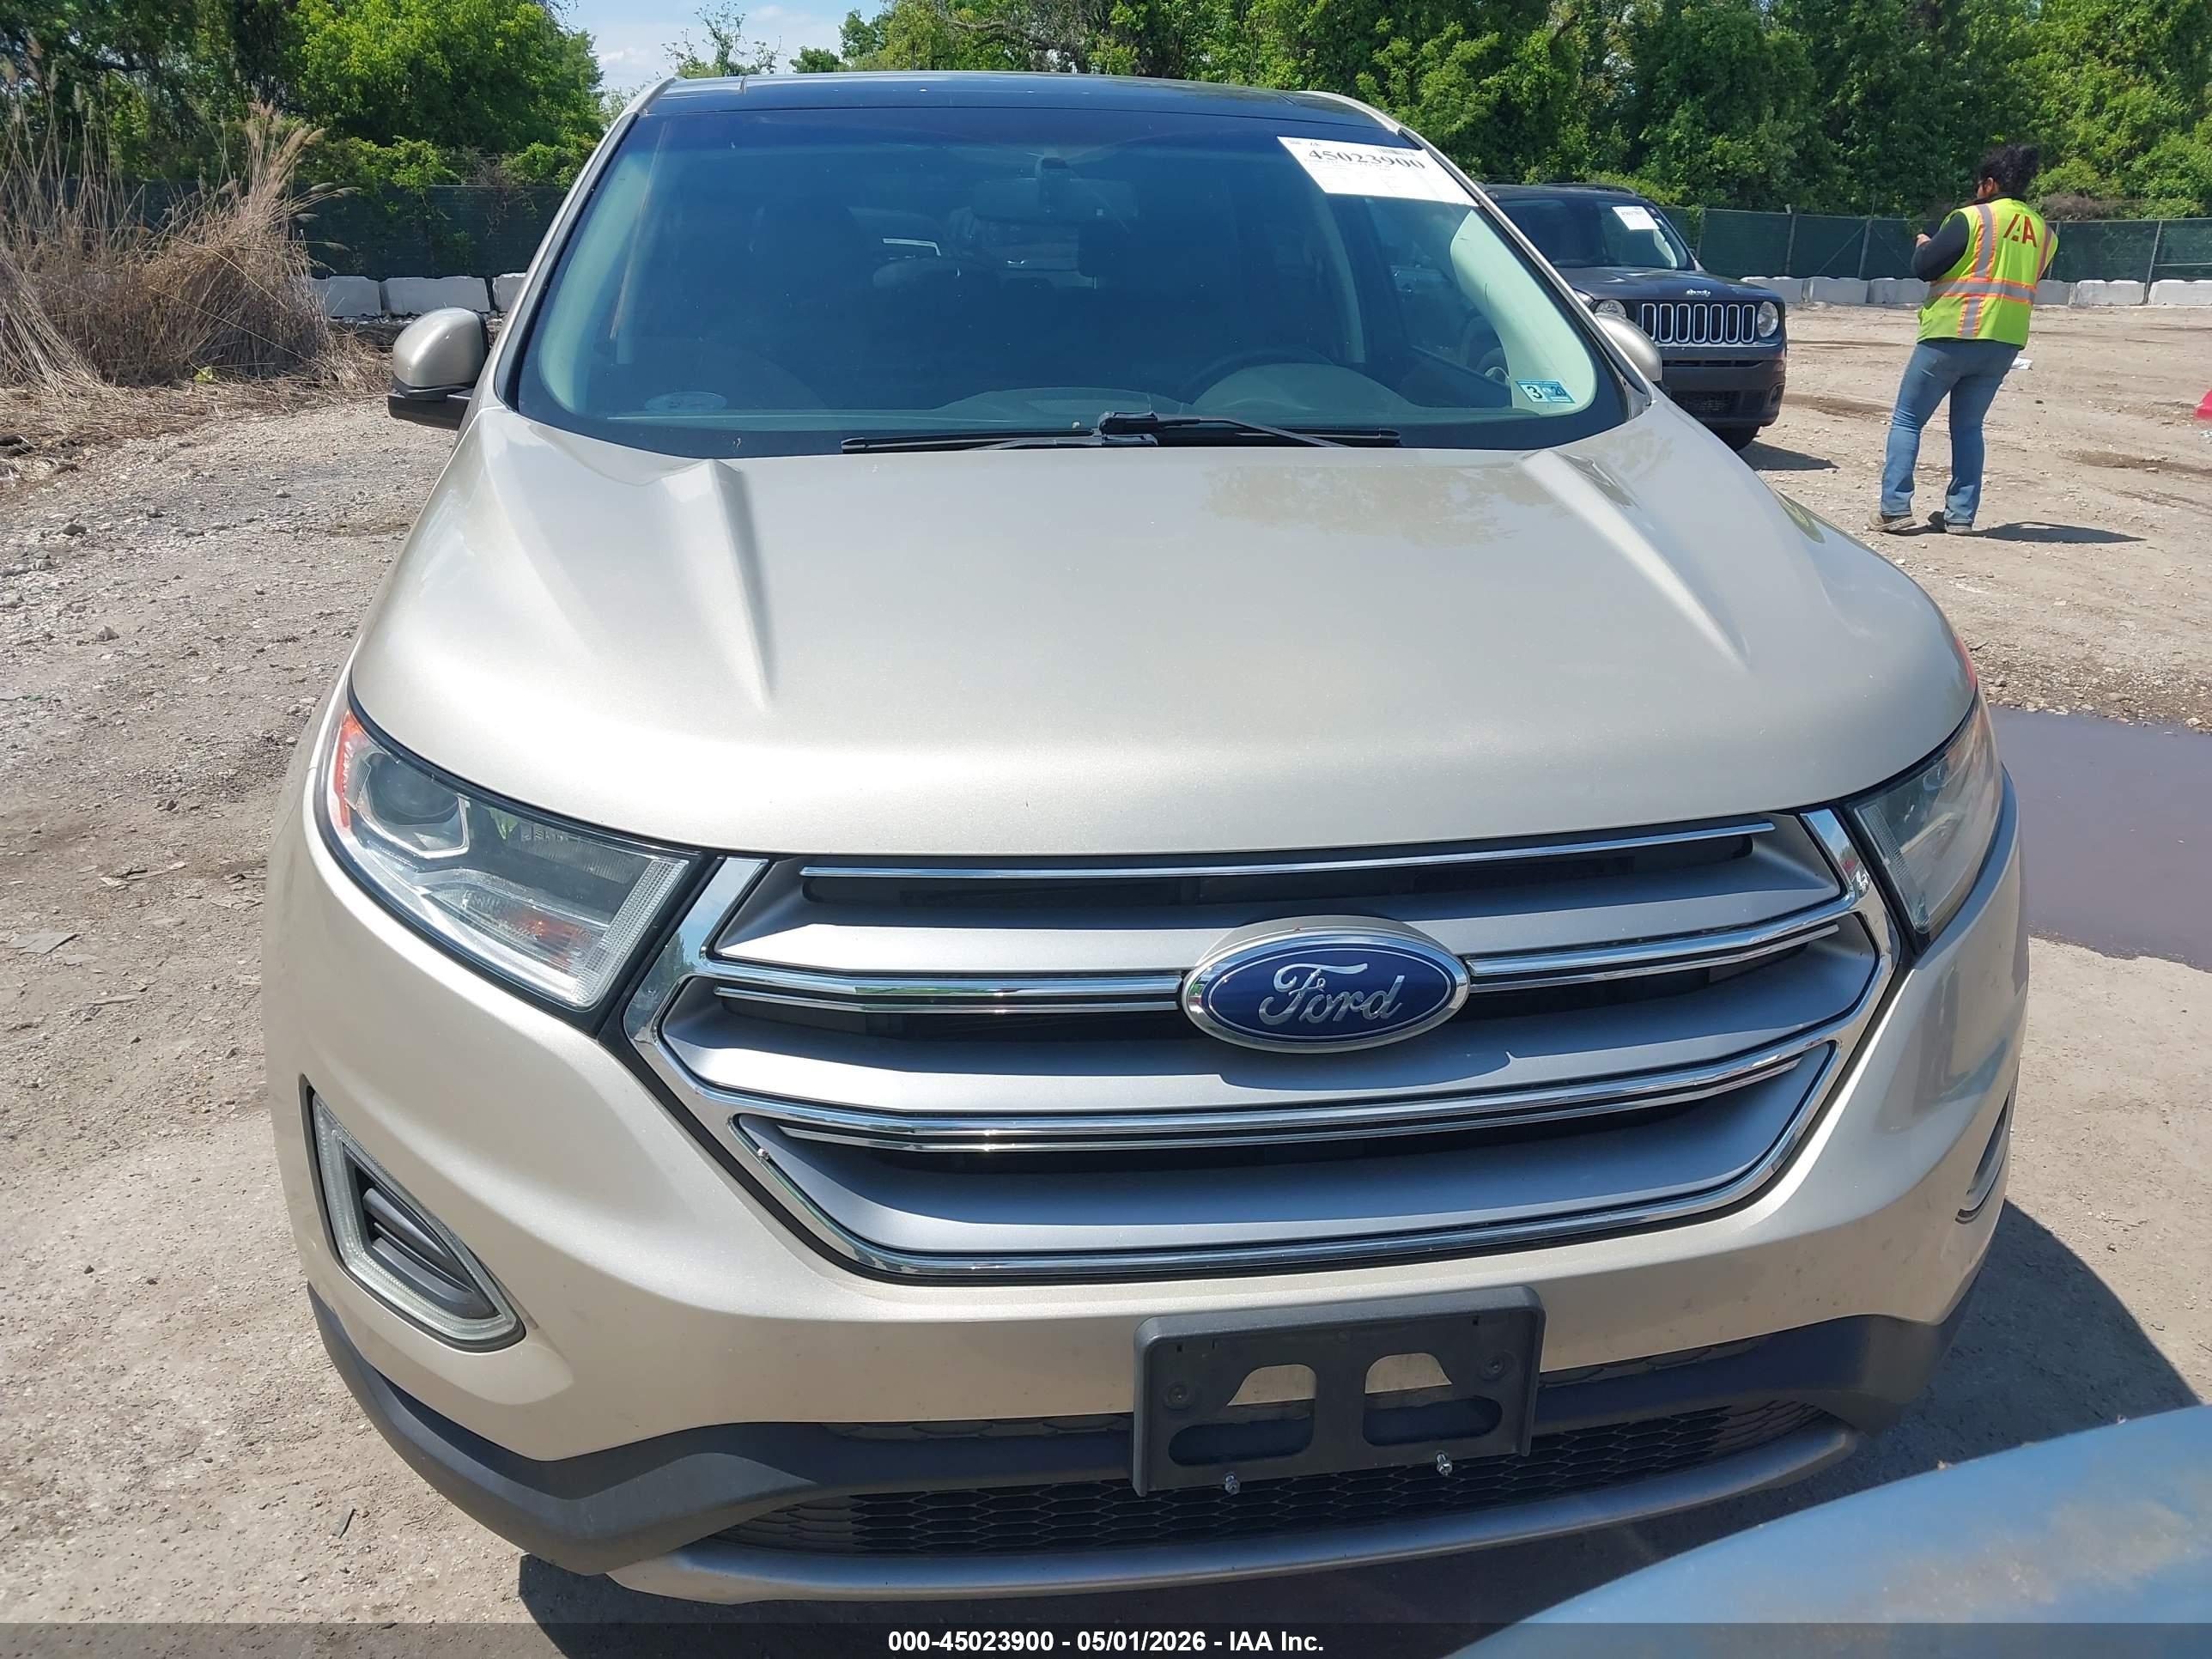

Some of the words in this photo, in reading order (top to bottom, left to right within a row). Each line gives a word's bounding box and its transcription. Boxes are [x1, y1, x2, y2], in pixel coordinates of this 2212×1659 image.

[1308, 149, 1425, 169] 45023900
[1527, 386, 1542, 398] 3
[1258, 963, 1406, 1025] Ford
